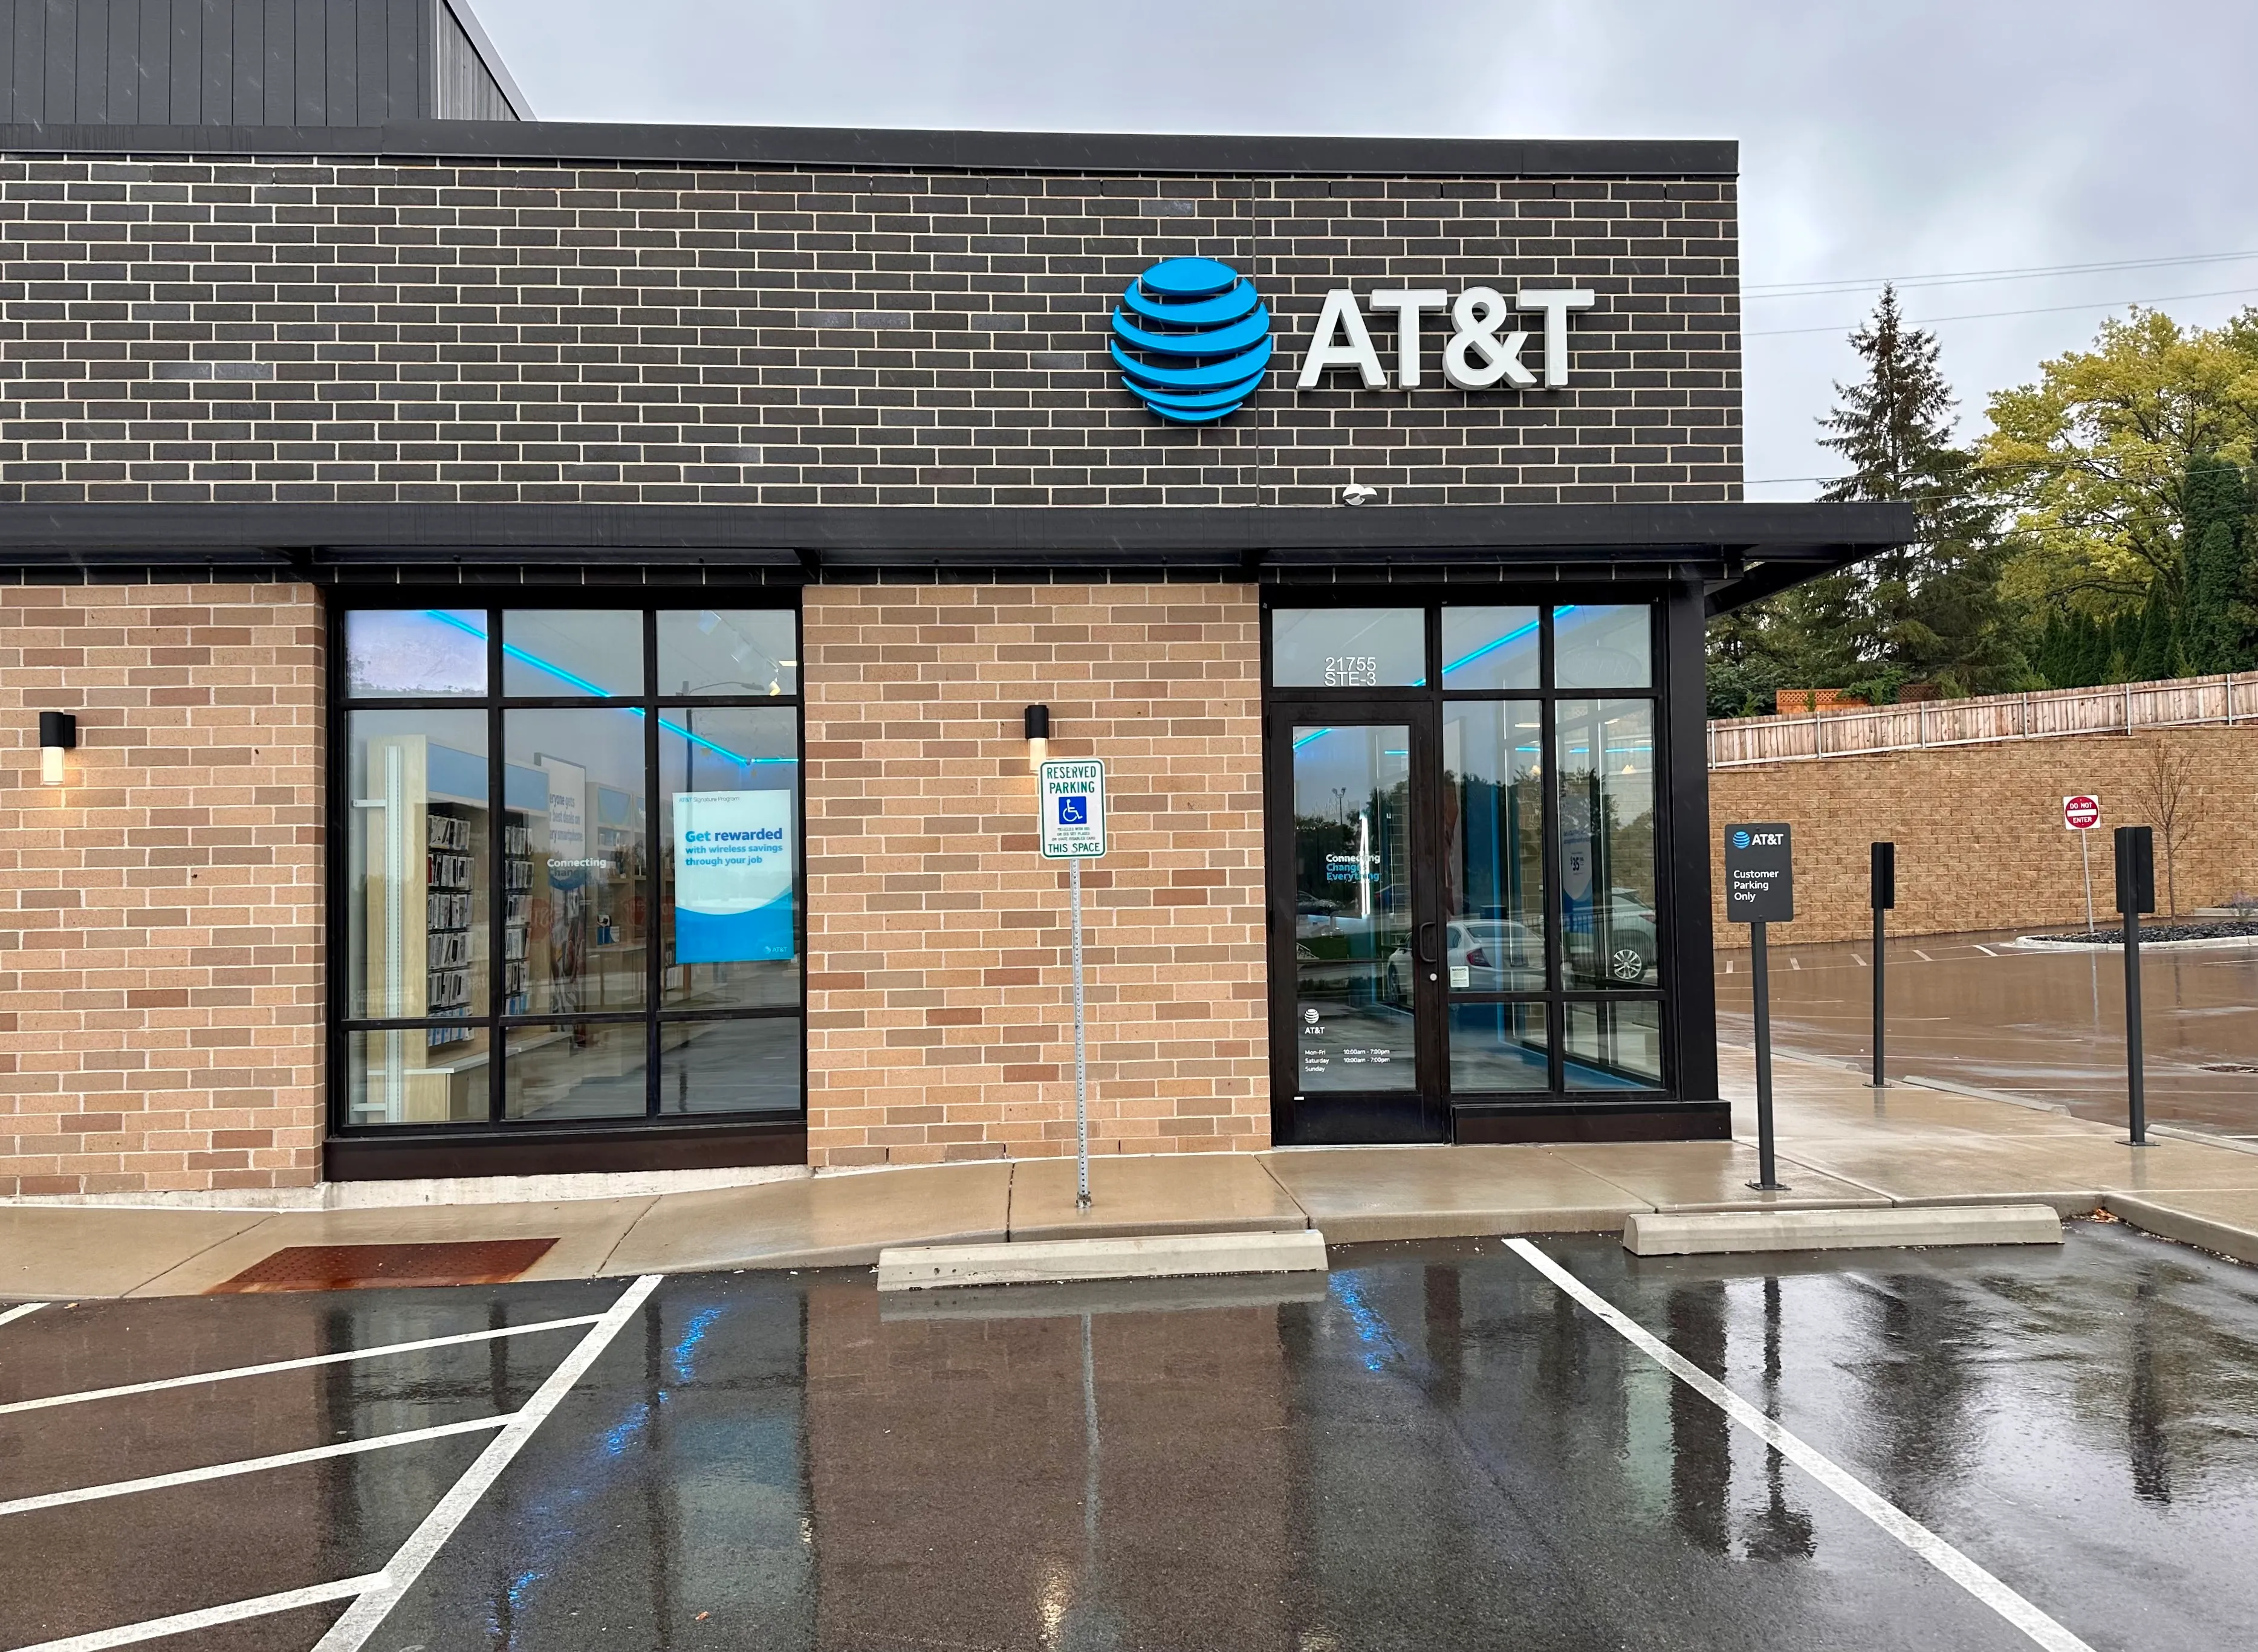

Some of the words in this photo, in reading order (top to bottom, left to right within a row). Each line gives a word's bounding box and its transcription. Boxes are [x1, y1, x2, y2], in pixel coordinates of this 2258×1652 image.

[1296, 287, 1595, 392] AT&T
[1325, 656, 1377, 672] 21755
[1324, 671, 1377, 687] STE-3
[1046, 766, 1096, 779] RESERVED
[1049, 781, 1095, 794] PARKING
[685, 831, 712, 843] Get
[715, 828, 783, 841] rewarded
[1751, 833, 1784, 846] AT&T
[685, 846, 706, 854] with
[709, 844, 747, 854] wireless
[748, 843, 783, 854] savings
[1048, 843, 1068, 853] THIS
[1071, 842, 1100, 853] SPACE
[547, 857, 607, 869] Connecting
[685, 857, 723, 867] through
[725, 857, 746, 866] your
[747, 855, 763, 866] job
[1326, 854, 1381, 864] Connecng
[1326, 863, 1365, 873] Change
[1733, 870, 1779, 878] Customer
[1326, 872, 1380, 882] Everytng
[1734, 880, 1769, 891] Parking
[1734, 892, 1756, 902] Only
